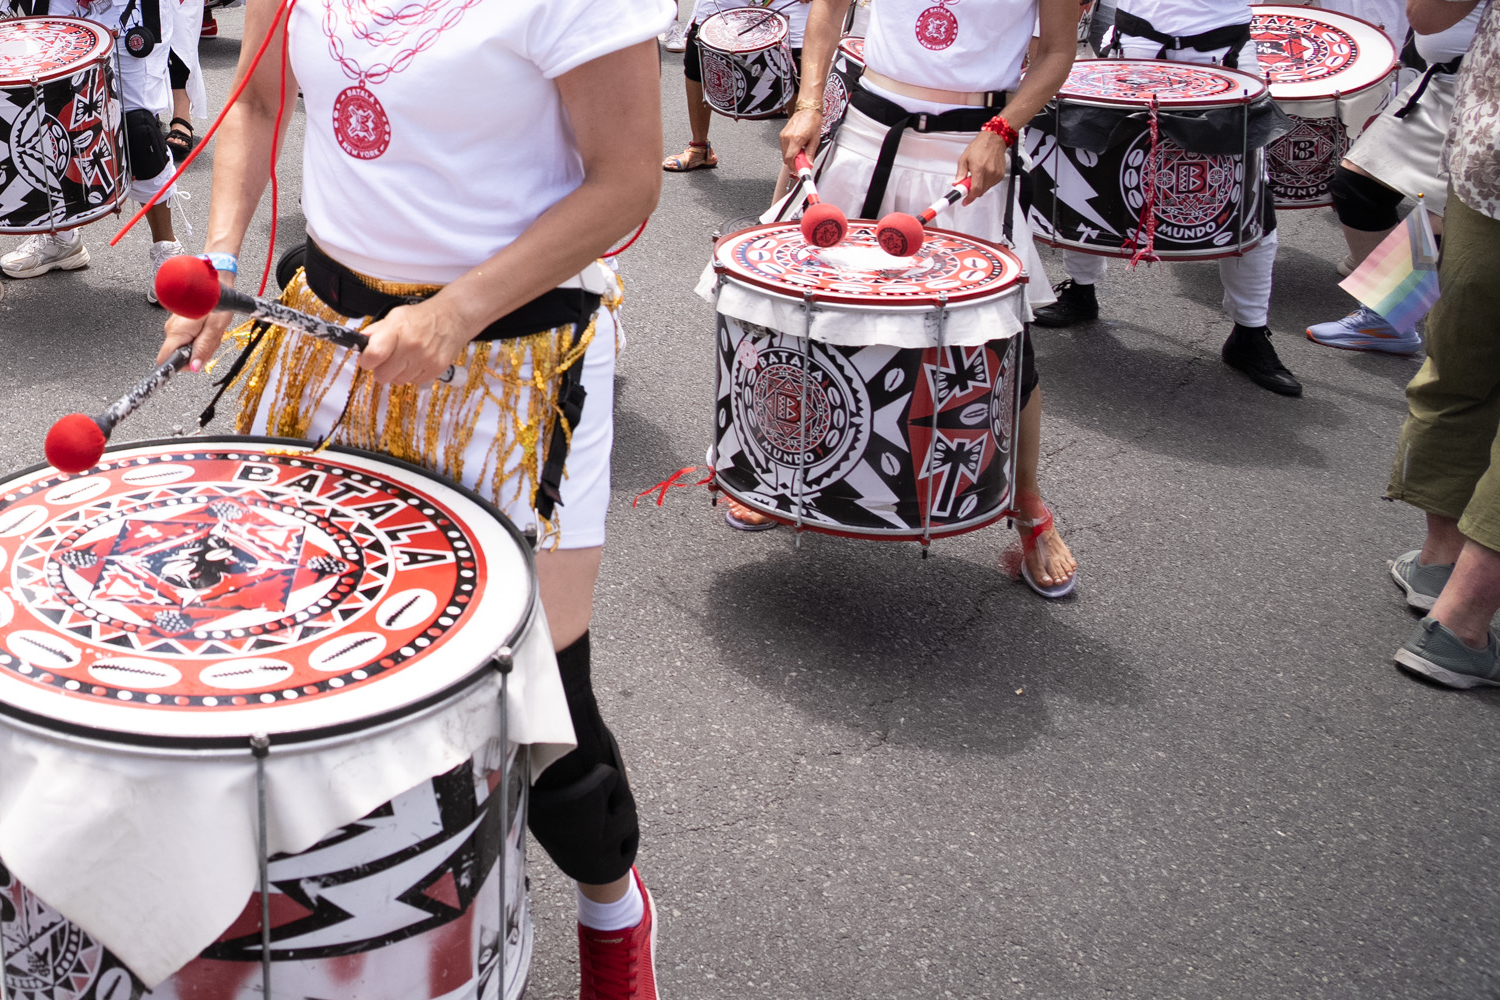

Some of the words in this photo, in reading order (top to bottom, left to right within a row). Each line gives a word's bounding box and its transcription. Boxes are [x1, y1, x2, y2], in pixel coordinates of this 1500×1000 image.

[342, 141, 359, 156] NEW
[360, 148, 381, 158] YORK
[1273, 183, 1328, 197] MUNDO
[1156, 221, 1217, 239] MUNDO
[761, 440, 815, 464] MUNDO
[234, 458, 457, 574] BATALA
